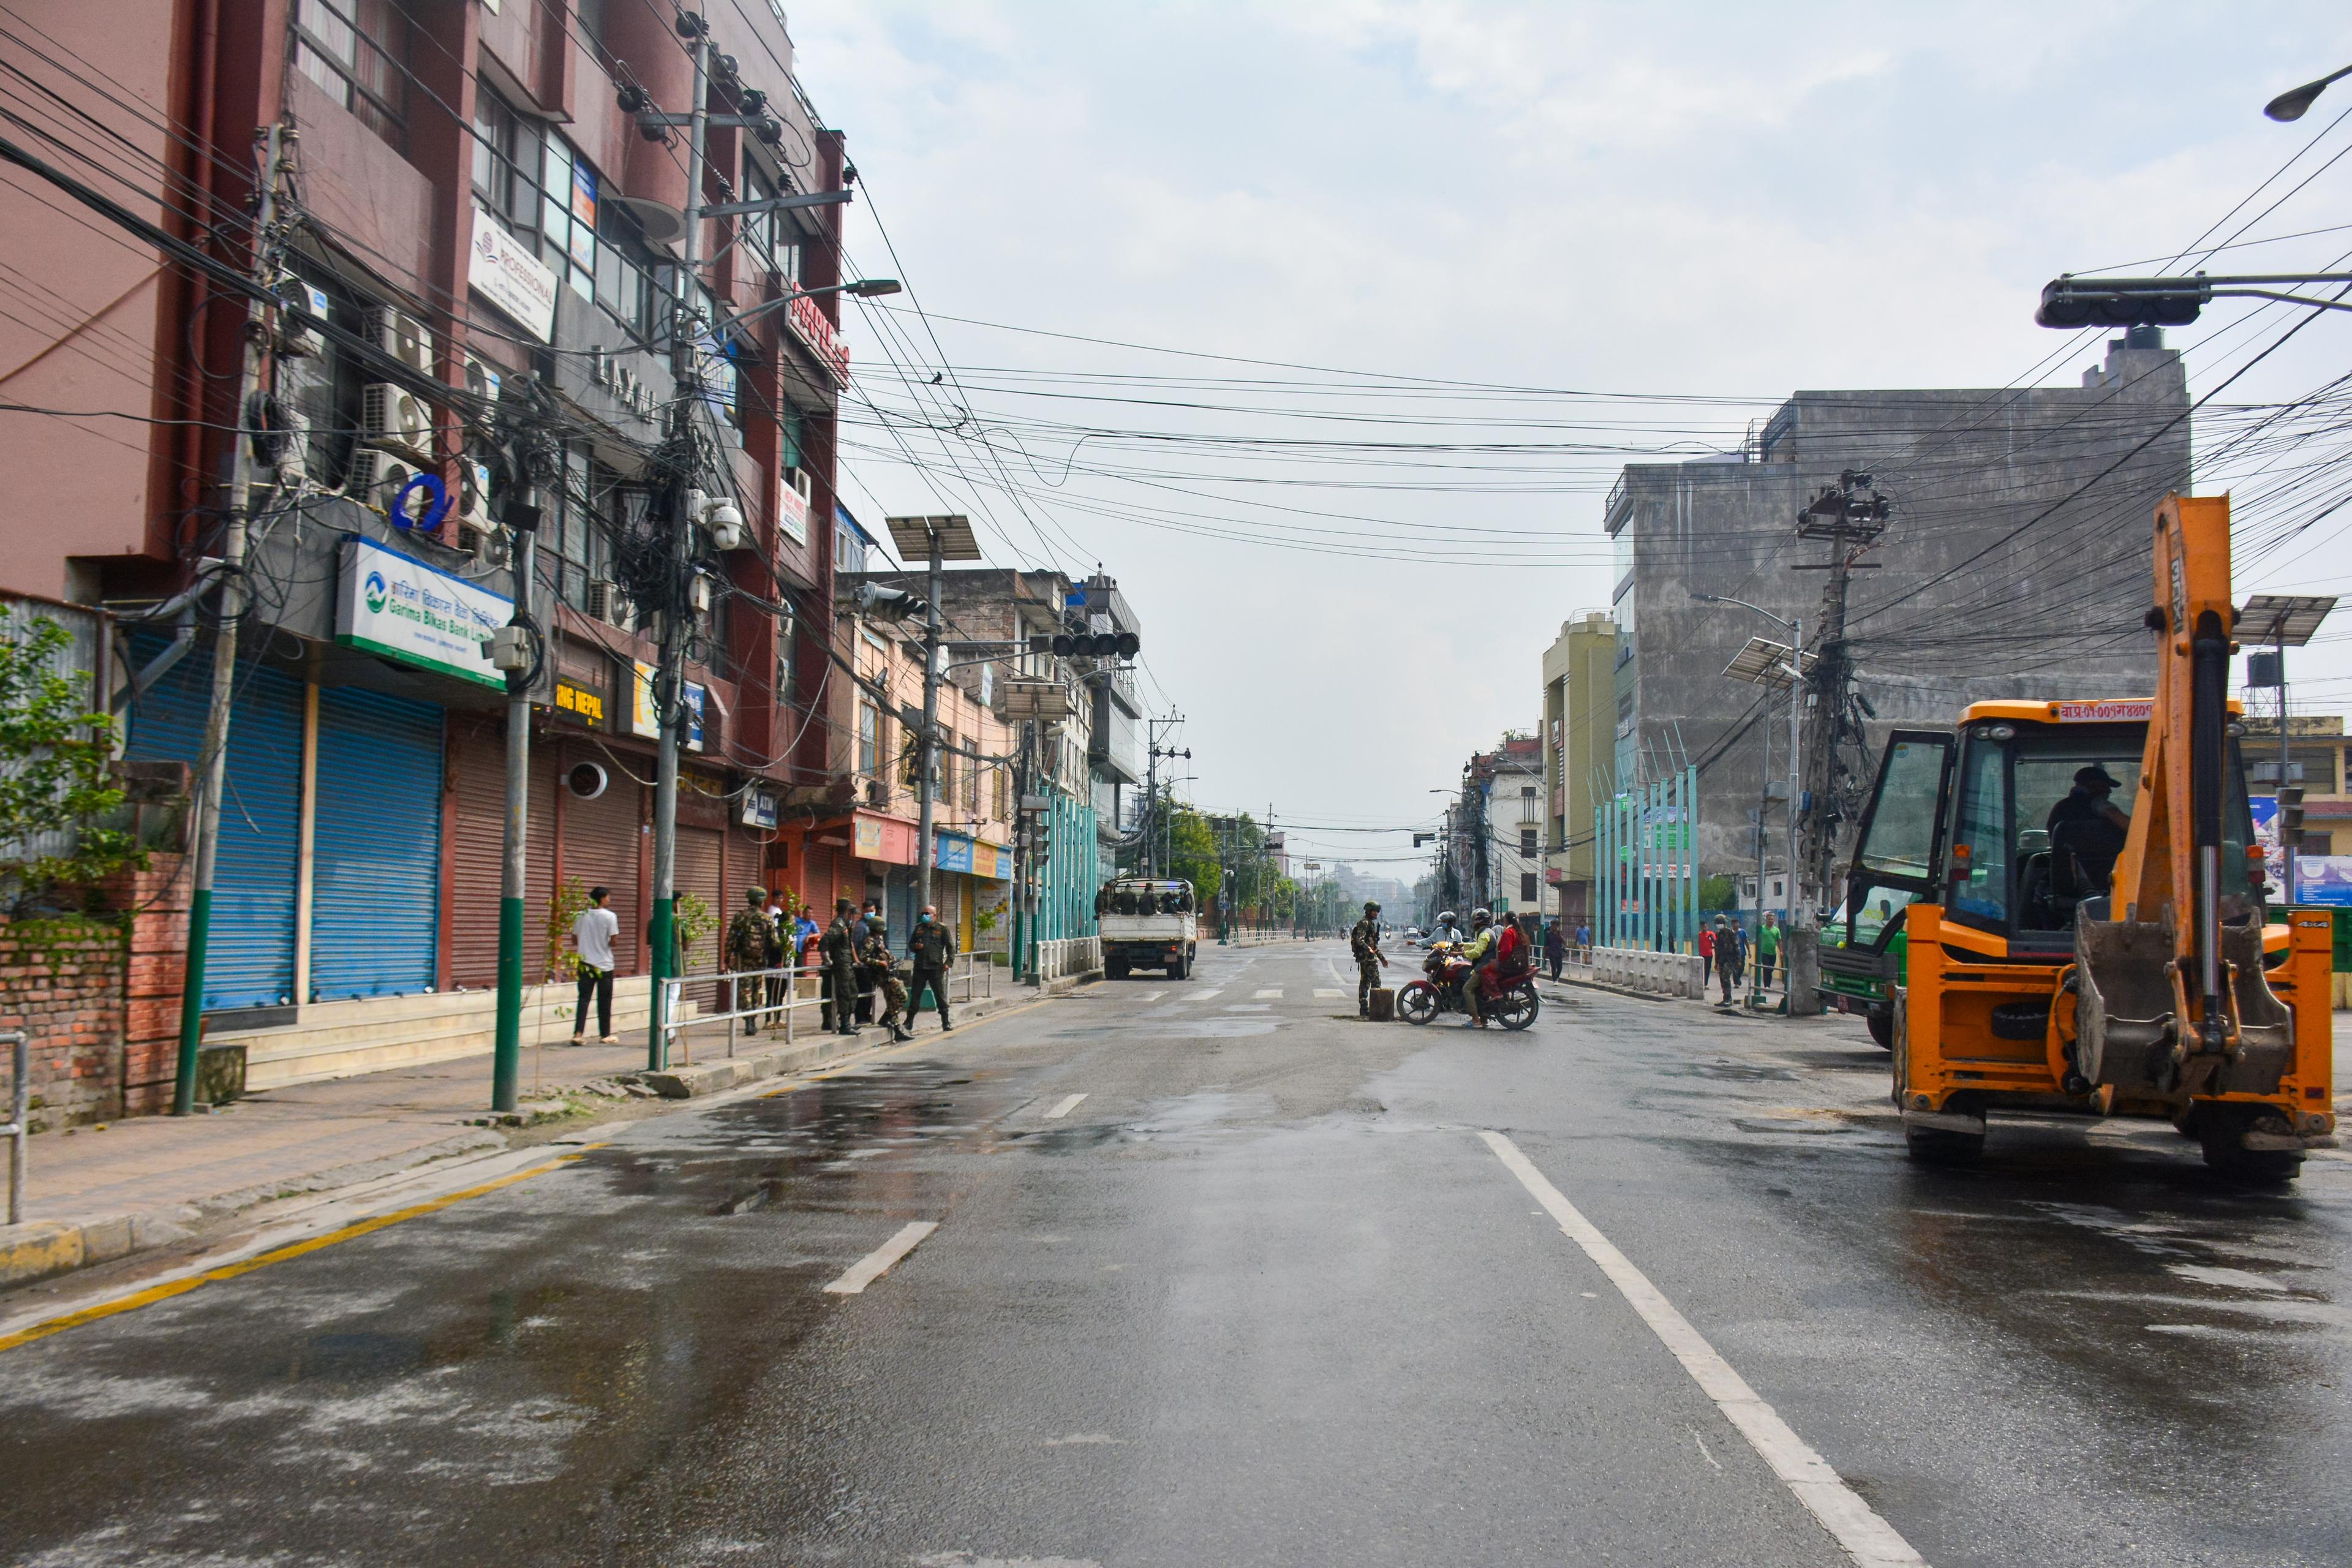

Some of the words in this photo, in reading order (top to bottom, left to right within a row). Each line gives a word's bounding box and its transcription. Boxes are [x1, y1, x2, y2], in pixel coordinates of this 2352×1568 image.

[389, 597, 421, 623] Garima
[423, 609, 447, 631] Bikas
[449, 619, 469, 639] Bank
[760, 795, 774, 812] ATM
[1864, 908, 1885, 922] eco
